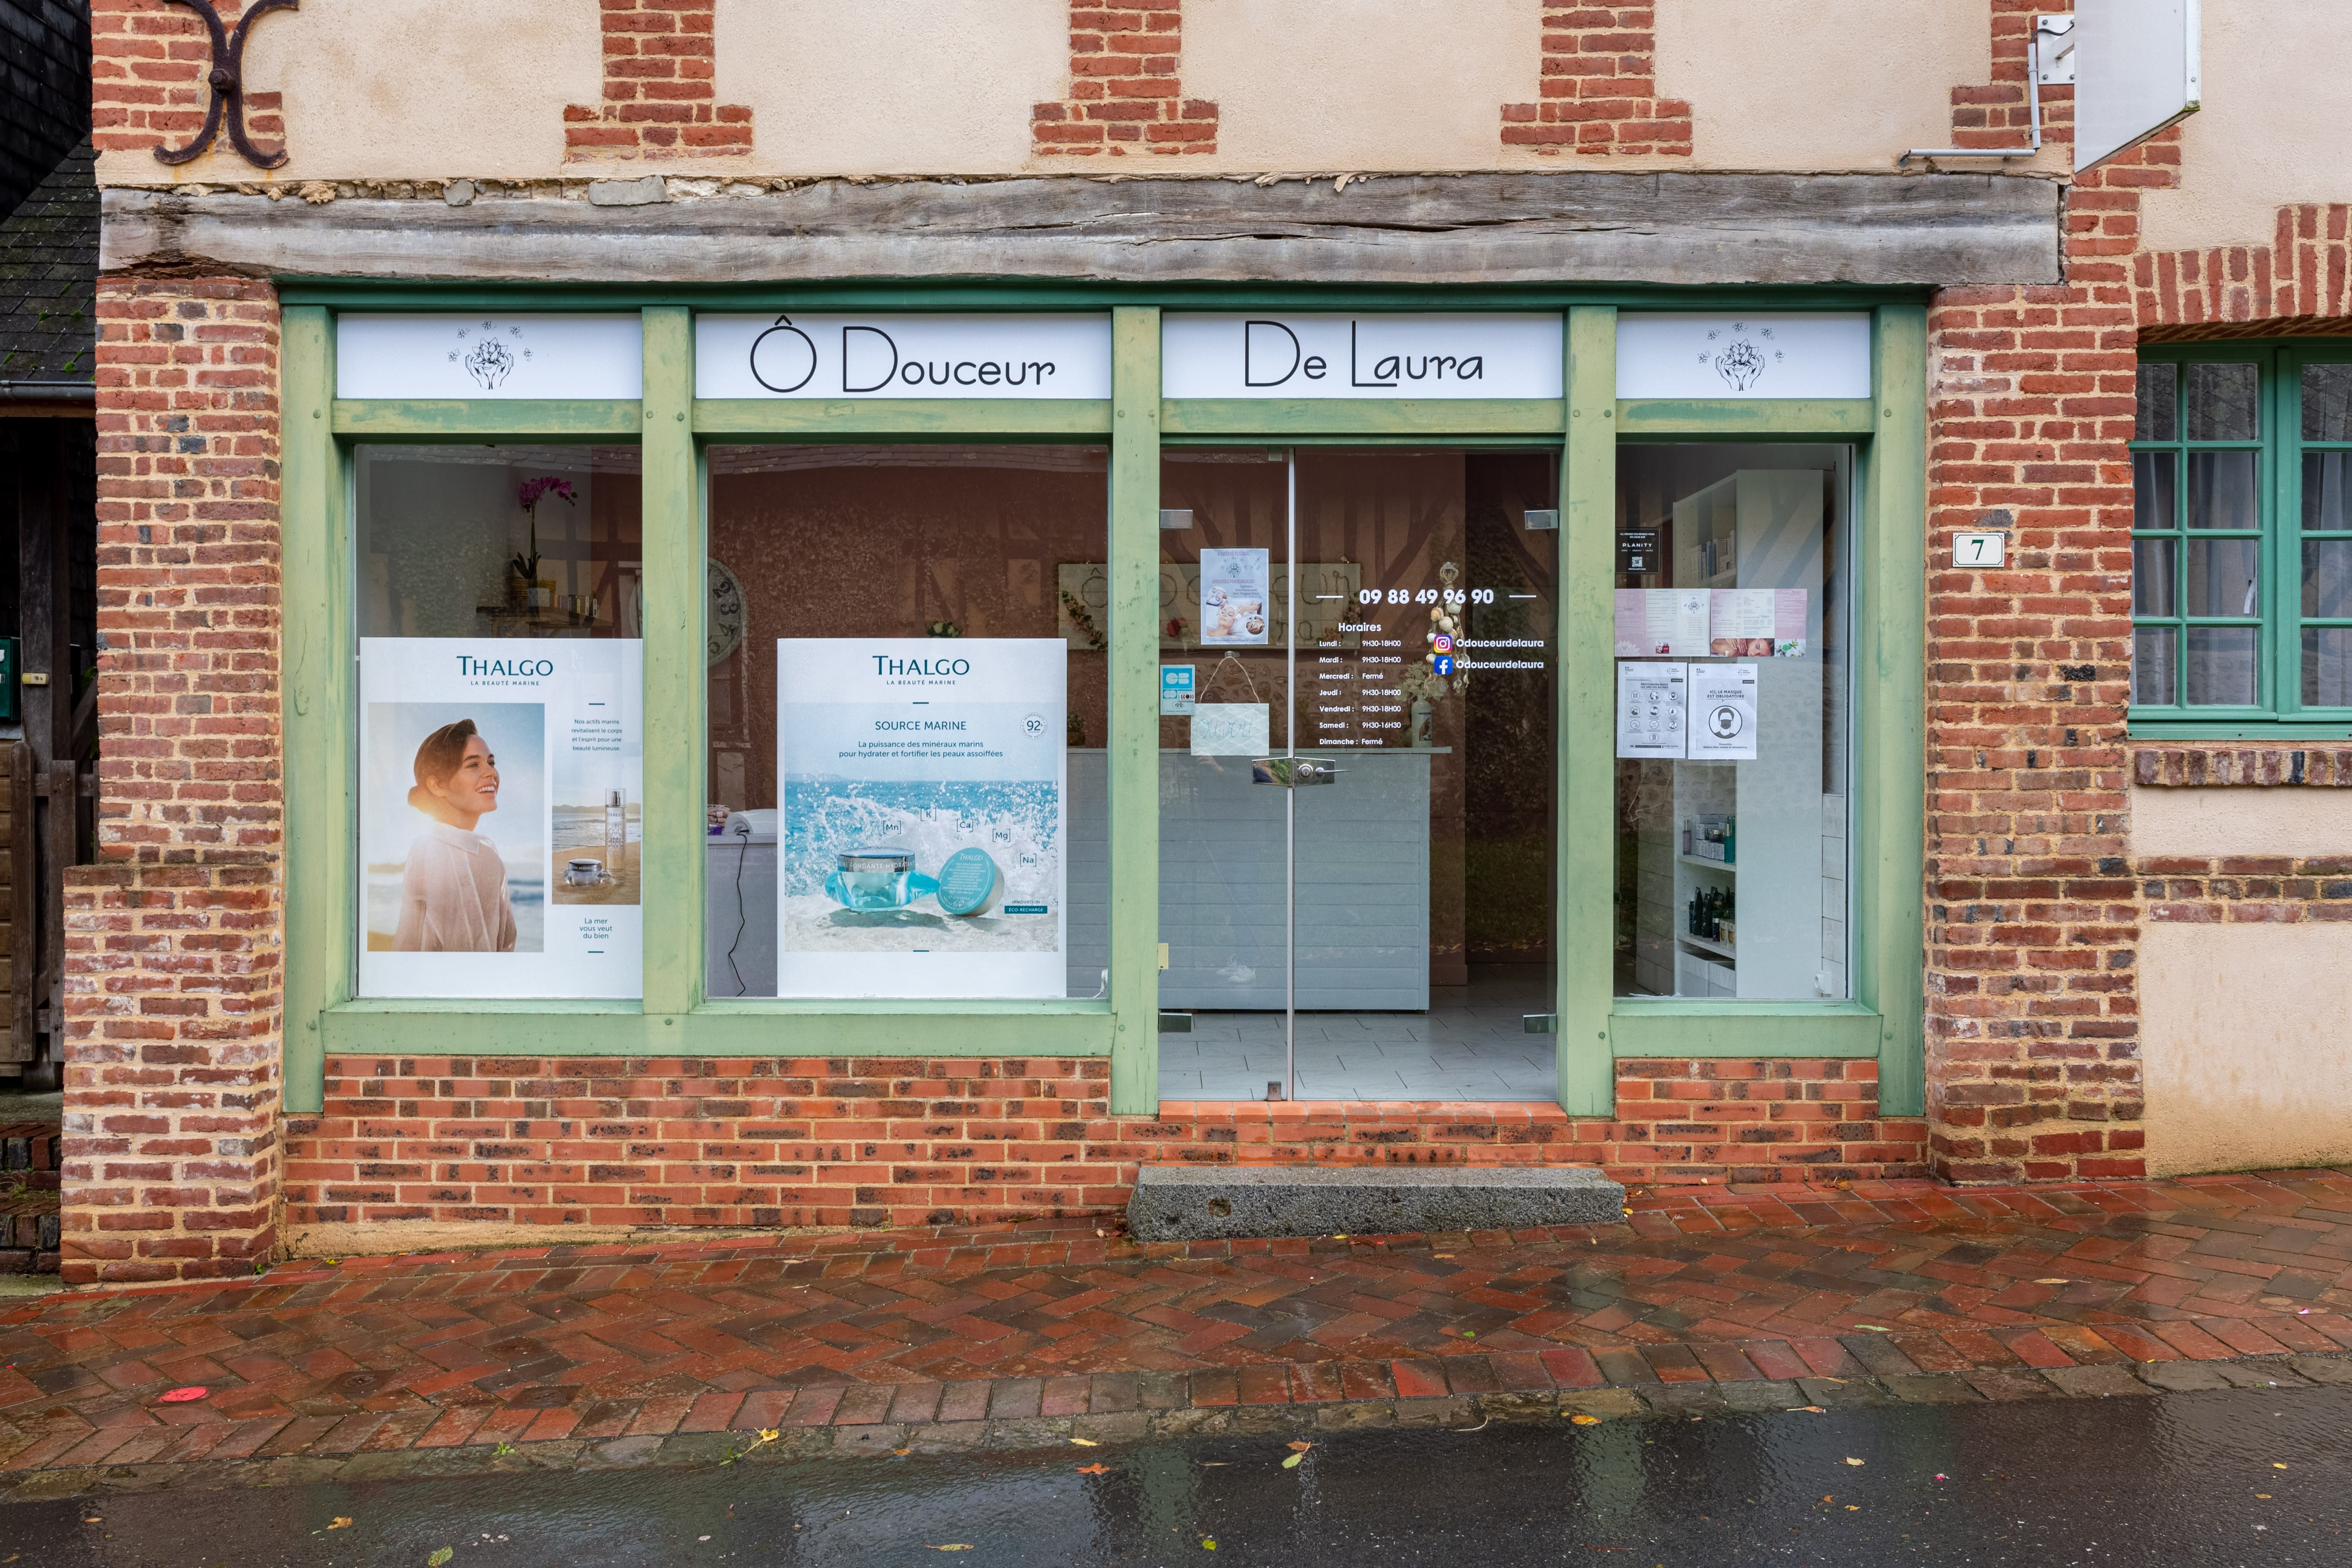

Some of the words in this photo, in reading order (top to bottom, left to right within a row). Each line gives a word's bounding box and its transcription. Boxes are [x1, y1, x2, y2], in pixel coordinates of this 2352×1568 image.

[751, 314, 817, 392] Ô
[843, 326, 1055, 392] Douceur
[1245, 320, 1326, 387] De
[1352, 320, 1483, 387] Laura
[1971, 539, 1984, 560] 7
[1359, 589, 1382, 604] 09
[1388, 589, 1410, 604] 88
[1415, 589, 1438, 604] 49
[1443, 589, 1466, 604] 96
[1471, 589, 1494, 604] 90
[1338, 622, 1381, 632] Horaires
[456, 656, 553, 676] THALGO
[872, 655, 970, 675] THALGO
[875, 721, 920, 730] SOURCE
[924, 721, 966, 730] MARINE
